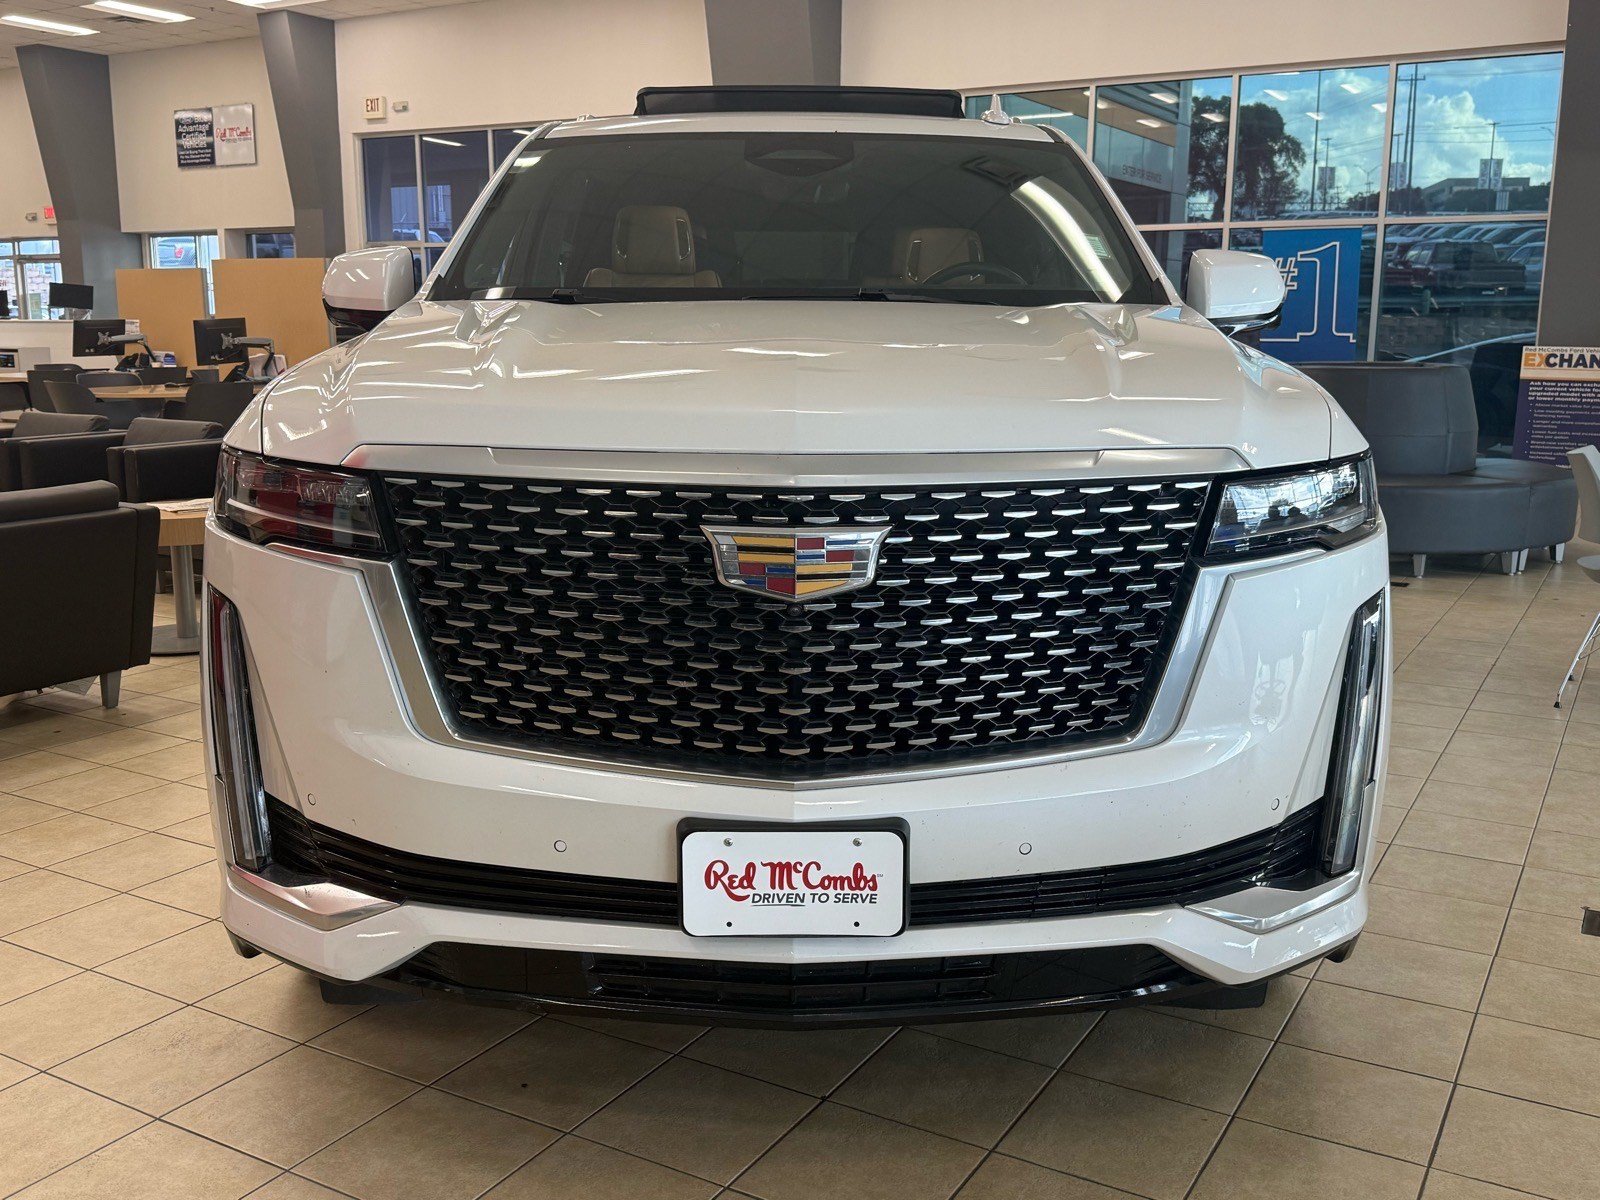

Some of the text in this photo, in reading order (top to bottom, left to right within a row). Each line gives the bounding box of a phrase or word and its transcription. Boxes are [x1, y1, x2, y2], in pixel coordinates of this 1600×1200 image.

[366, 98, 379, 112] EXIT
[704, 859, 878, 902] Red McCombs
[751, 892, 877, 904] DRIVEN TO SERVE
